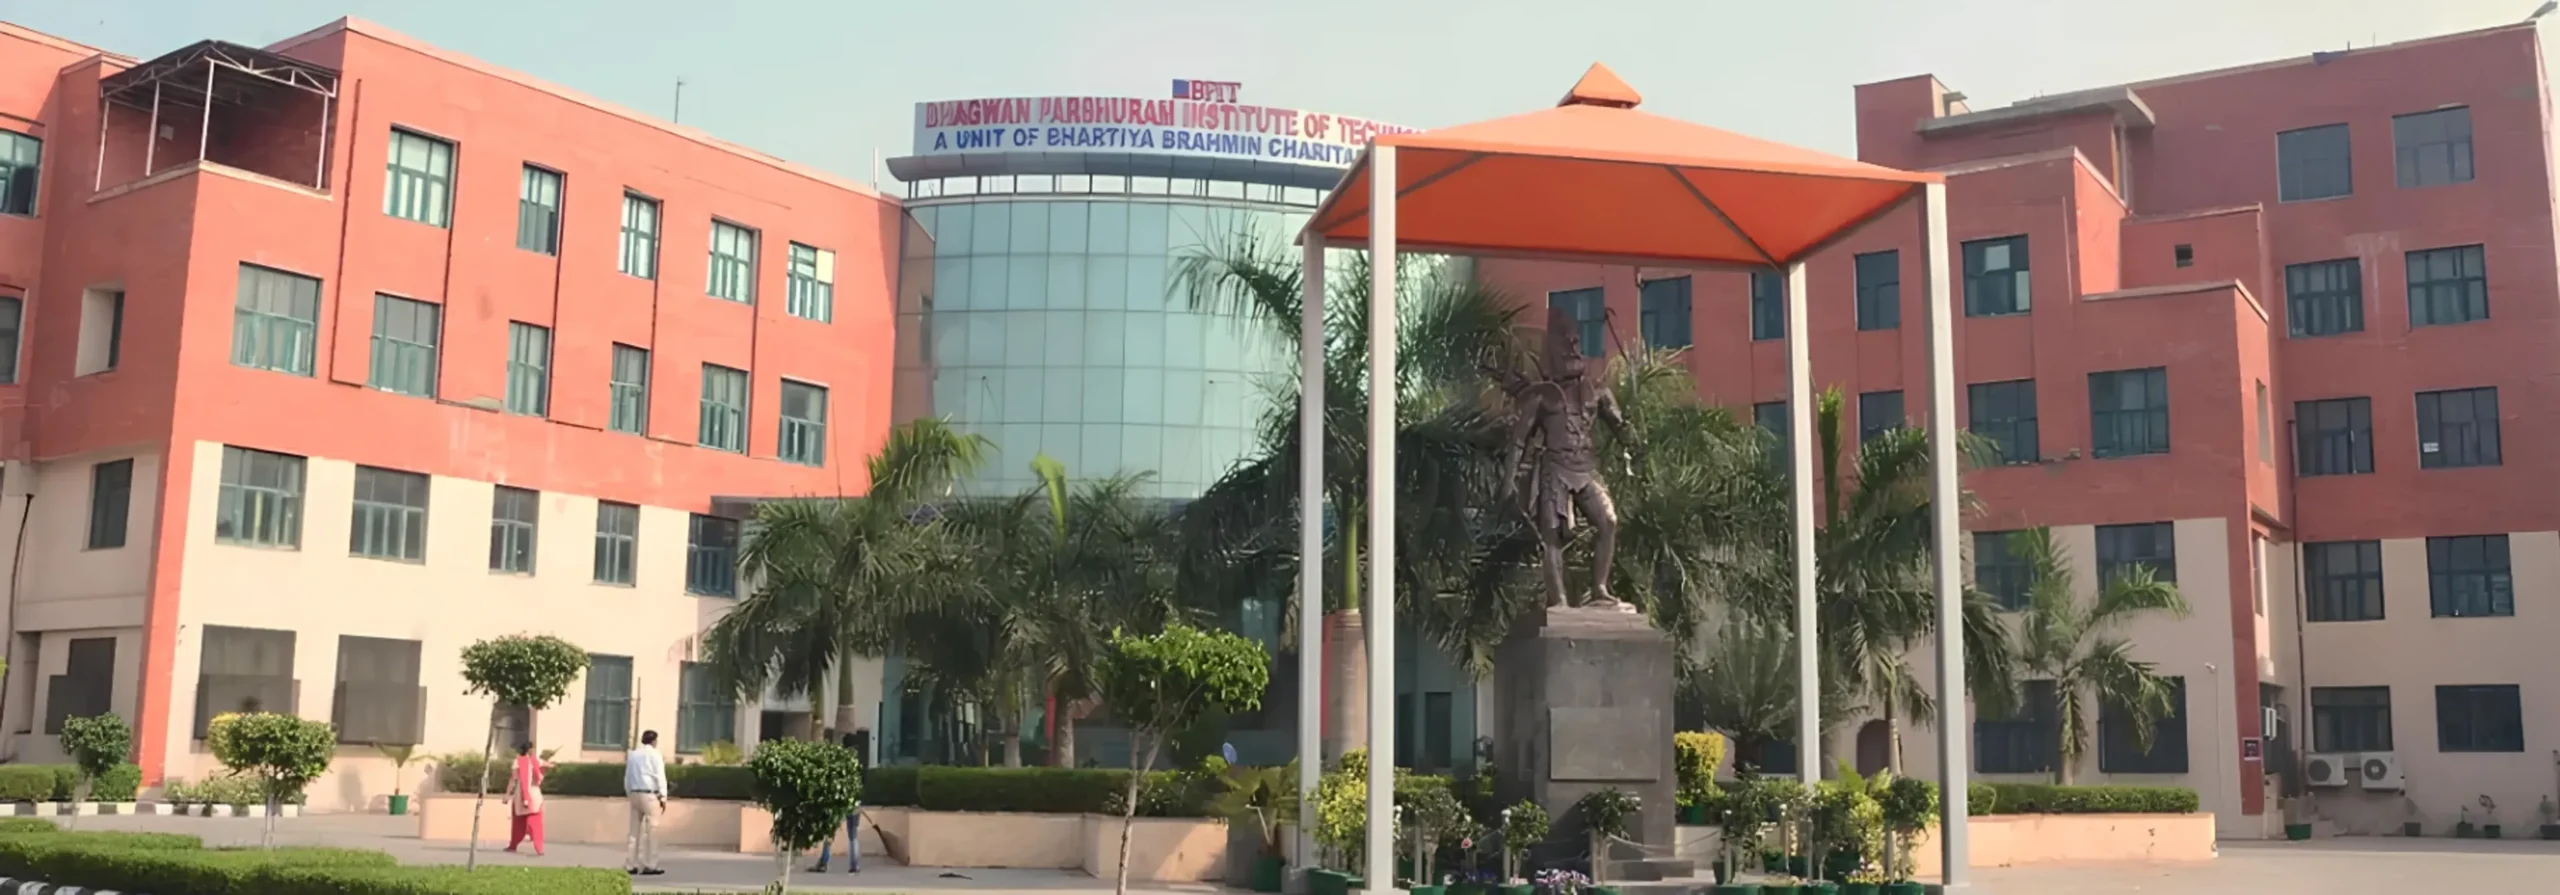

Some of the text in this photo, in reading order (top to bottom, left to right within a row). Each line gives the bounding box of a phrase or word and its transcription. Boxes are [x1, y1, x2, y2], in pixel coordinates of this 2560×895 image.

[1304, 113, 1330, 140] OF
[934, 131, 948, 151] A
[957, 128, 1006, 149] UNIT
[1013, 128, 1039, 147] OF
[1047, 127, 1154, 148] BHARTIYA
[1162, 130, 1262, 155] BRAHMIN
